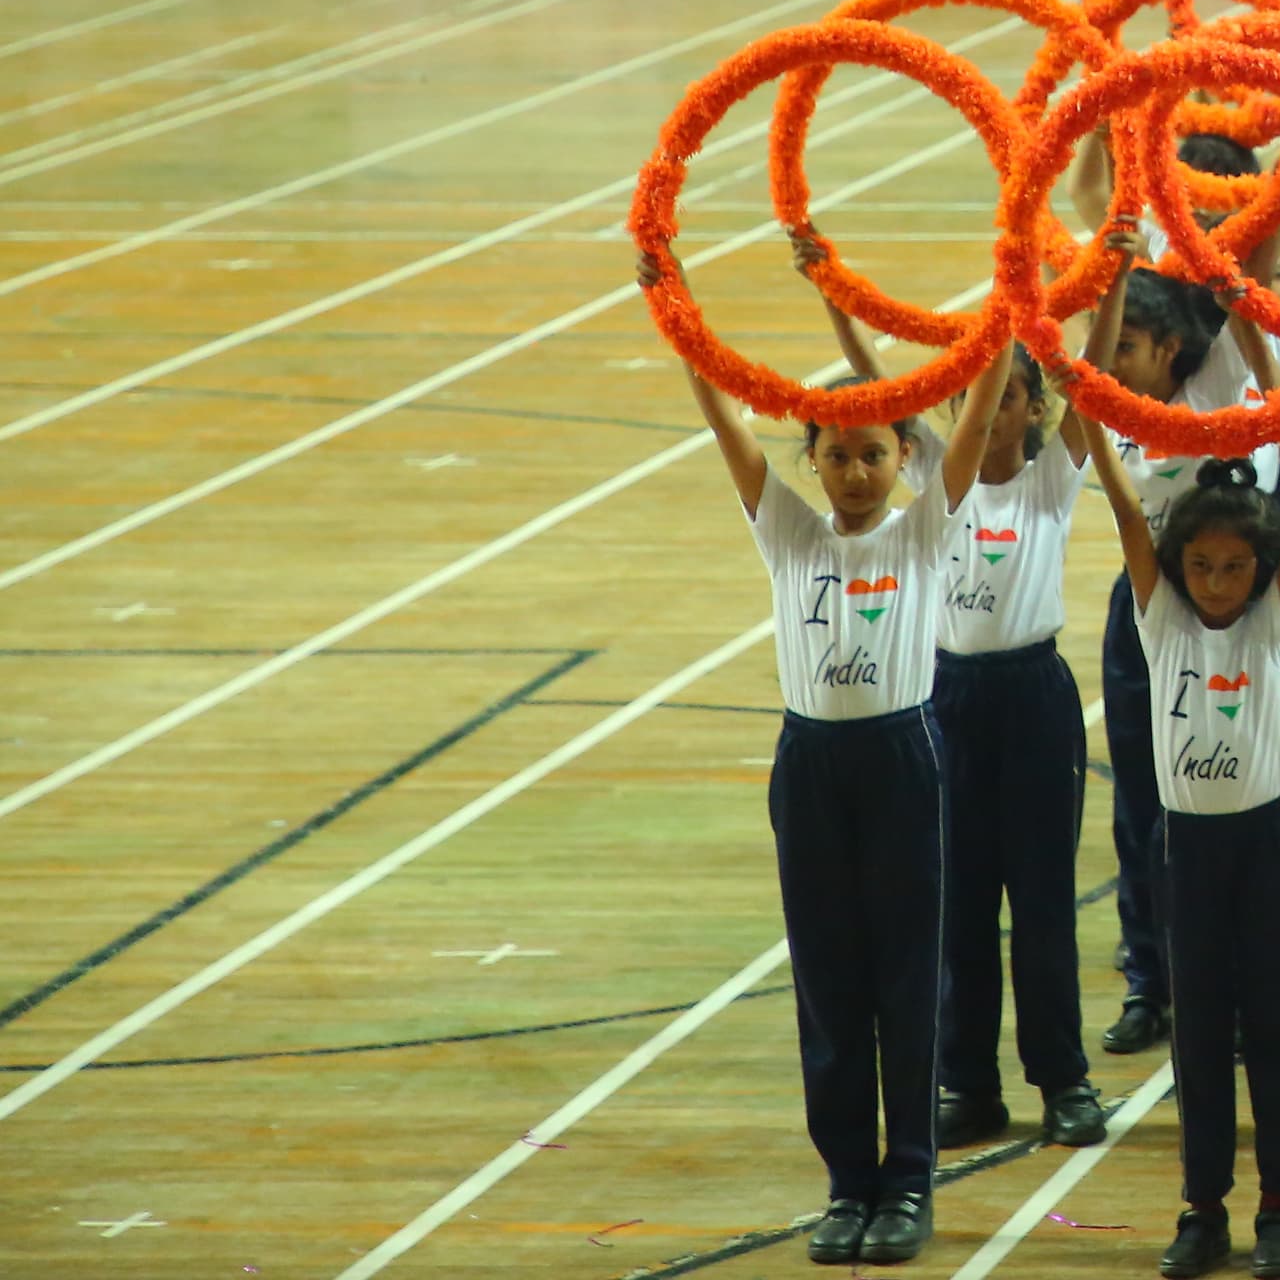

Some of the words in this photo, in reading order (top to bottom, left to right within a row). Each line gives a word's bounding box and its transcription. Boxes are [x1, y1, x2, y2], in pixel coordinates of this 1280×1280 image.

[804, 575, 841, 625] I
[814, 641, 879, 688] India
[1170, 669, 1200, 719] I
[1172, 735, 1240, 782] India
